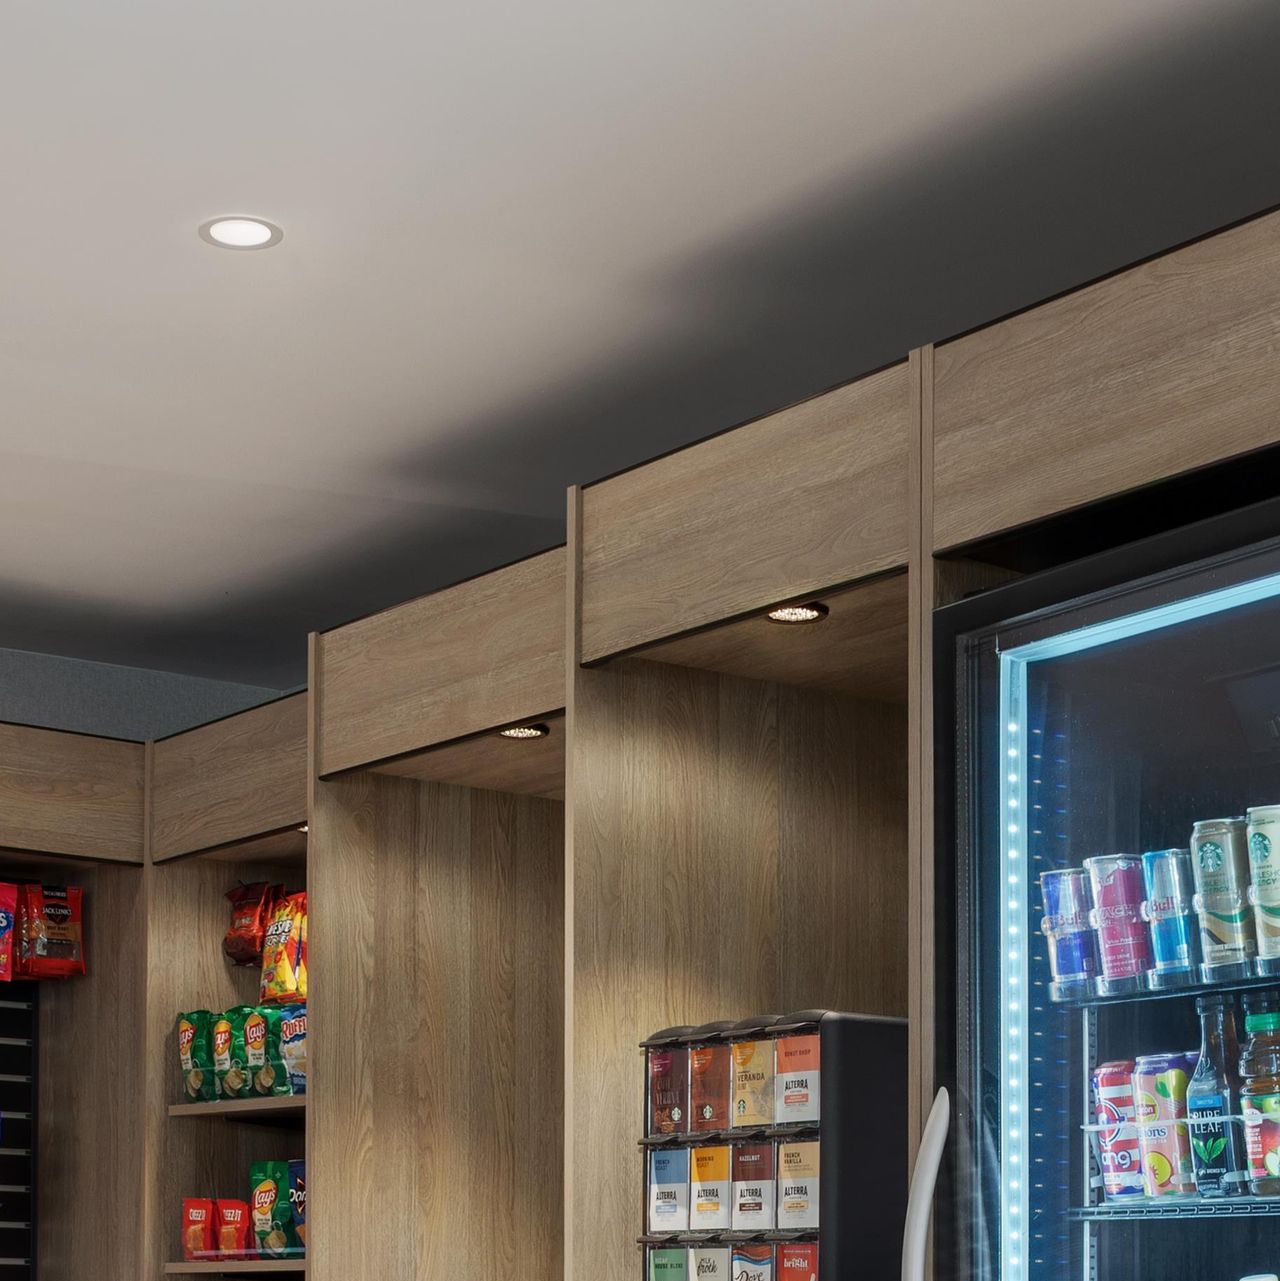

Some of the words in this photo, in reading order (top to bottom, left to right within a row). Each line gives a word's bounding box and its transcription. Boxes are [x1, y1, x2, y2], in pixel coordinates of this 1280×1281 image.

[245, 1019, 266, 1044] Lay's
[737, 1072, 765, 1082] VERANDA
[784, 1078, 809, 1091] ALTERRA
[739, 1154, 760, 1162] HAZELNUT
[1102, 1151, 1132, 1168] ang
[656, 1191, 677, 1201] ALTERRA
[697, 1188, 719, 1198] ALTERRA
[739, 1187, 762, 1198] ALTERRA
[784, 1185, 808, 1197] ALTERRA
[254, 1186, 276, 1209] Lay's
[784, 1258, 808, 1268] bright
